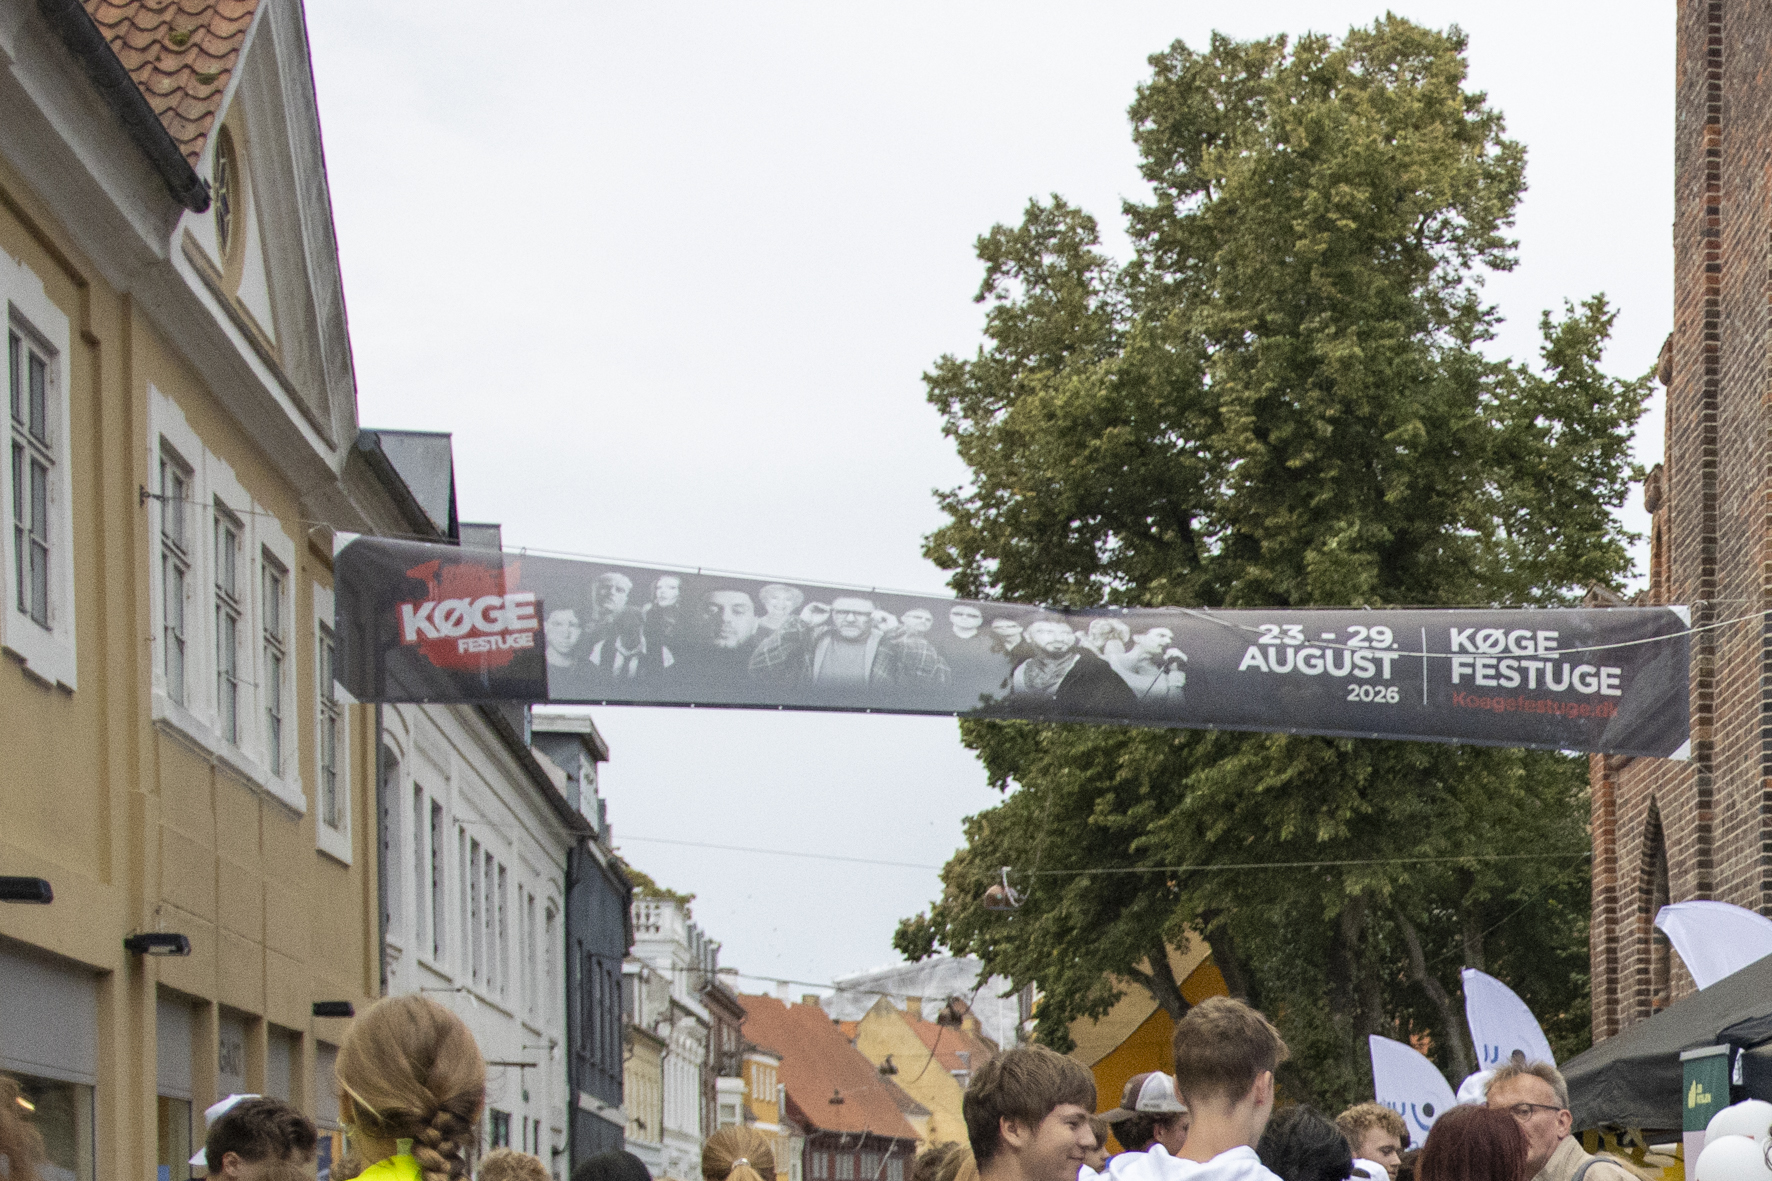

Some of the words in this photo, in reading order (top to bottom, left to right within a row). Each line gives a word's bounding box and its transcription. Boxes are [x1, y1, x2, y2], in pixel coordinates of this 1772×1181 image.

[401, 592, 539, 642] KØGE
[458, 632, 535, 654] FESTUGE
[1258, 624, 1309, 645] 23.
[1346, 625, 1399, 649] 29.
[1450, 627, 1560, 659] KØGE
[1238, 645, 1400, 680] AUGUST
[1451, 657, 1623, 697] FESTUGE
[1346, 683, 1400, 704] 2026
